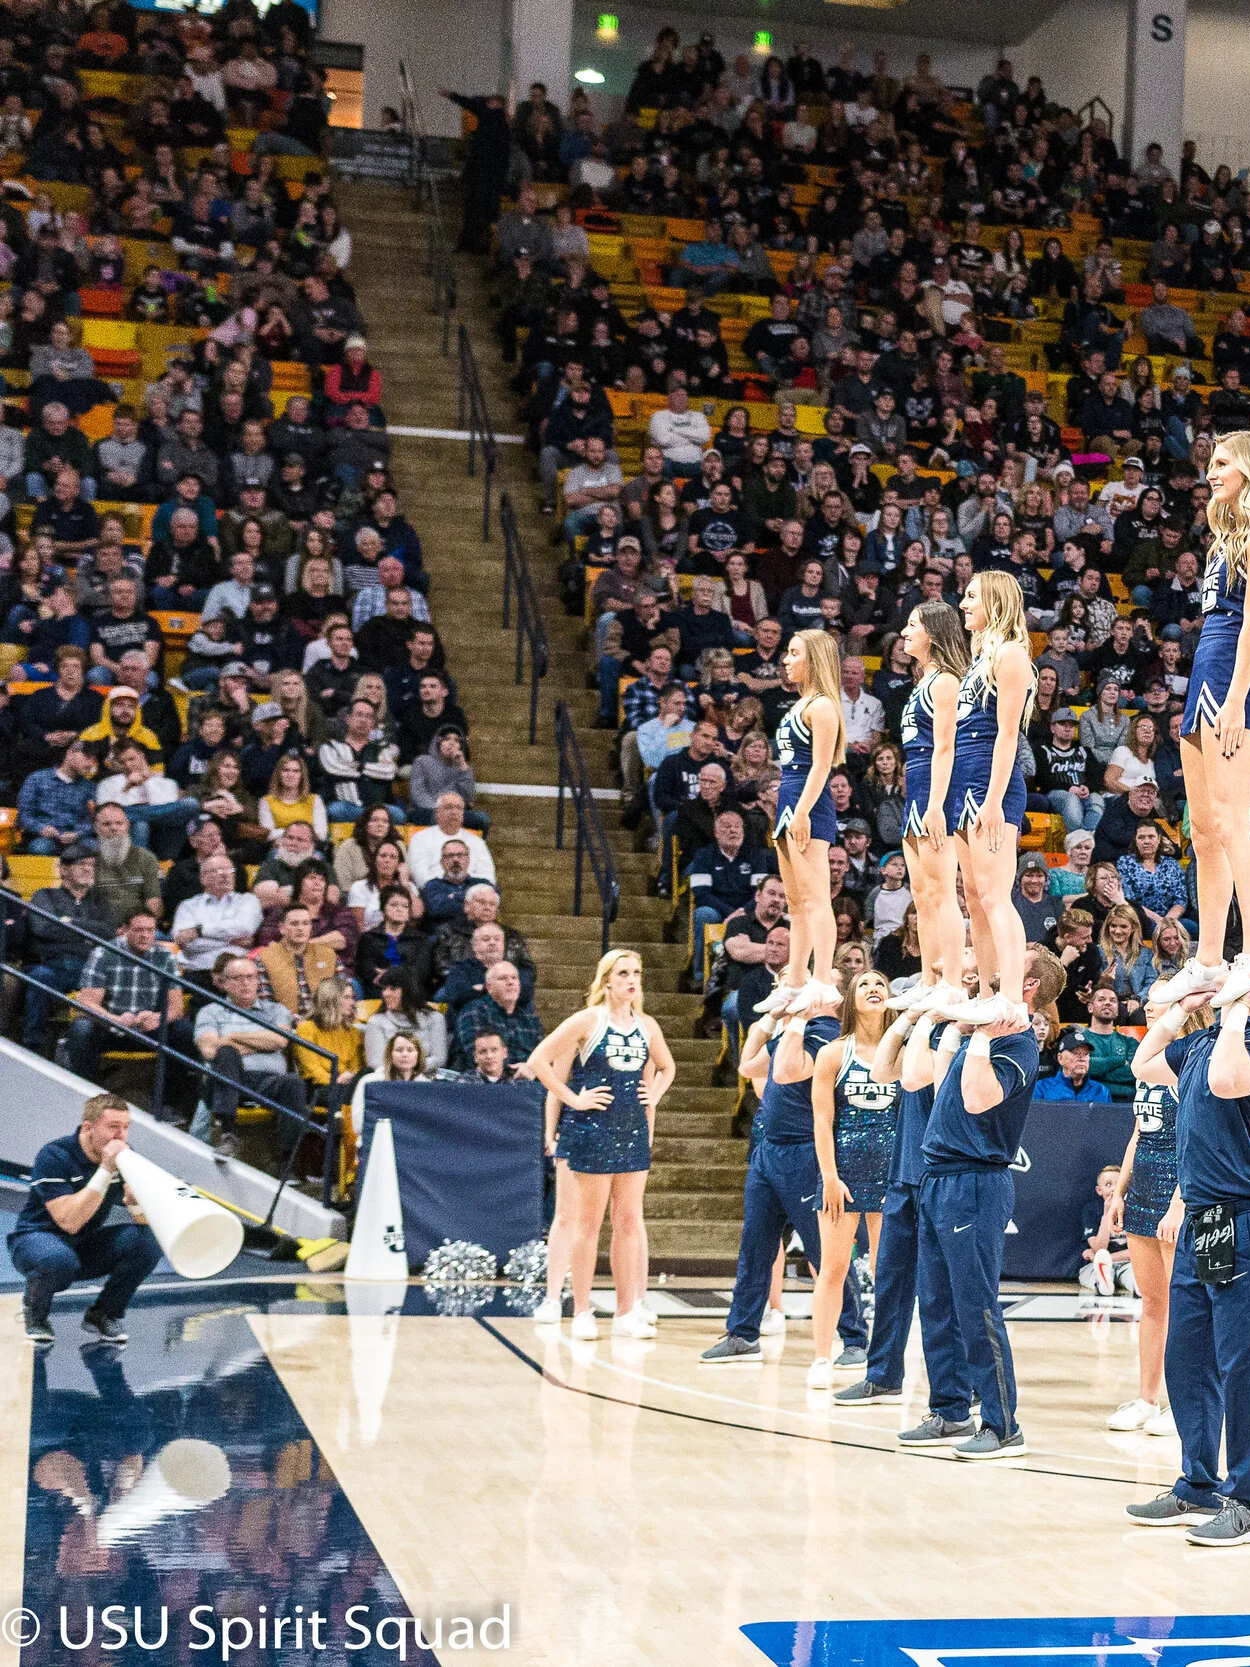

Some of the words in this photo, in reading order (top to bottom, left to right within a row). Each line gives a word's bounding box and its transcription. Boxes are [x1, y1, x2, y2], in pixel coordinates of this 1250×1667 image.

[1151, 13, 1173, 42] S
[605, 1044, 648, 1060] STATE
[844, 1082, 897, 1097] STATE
